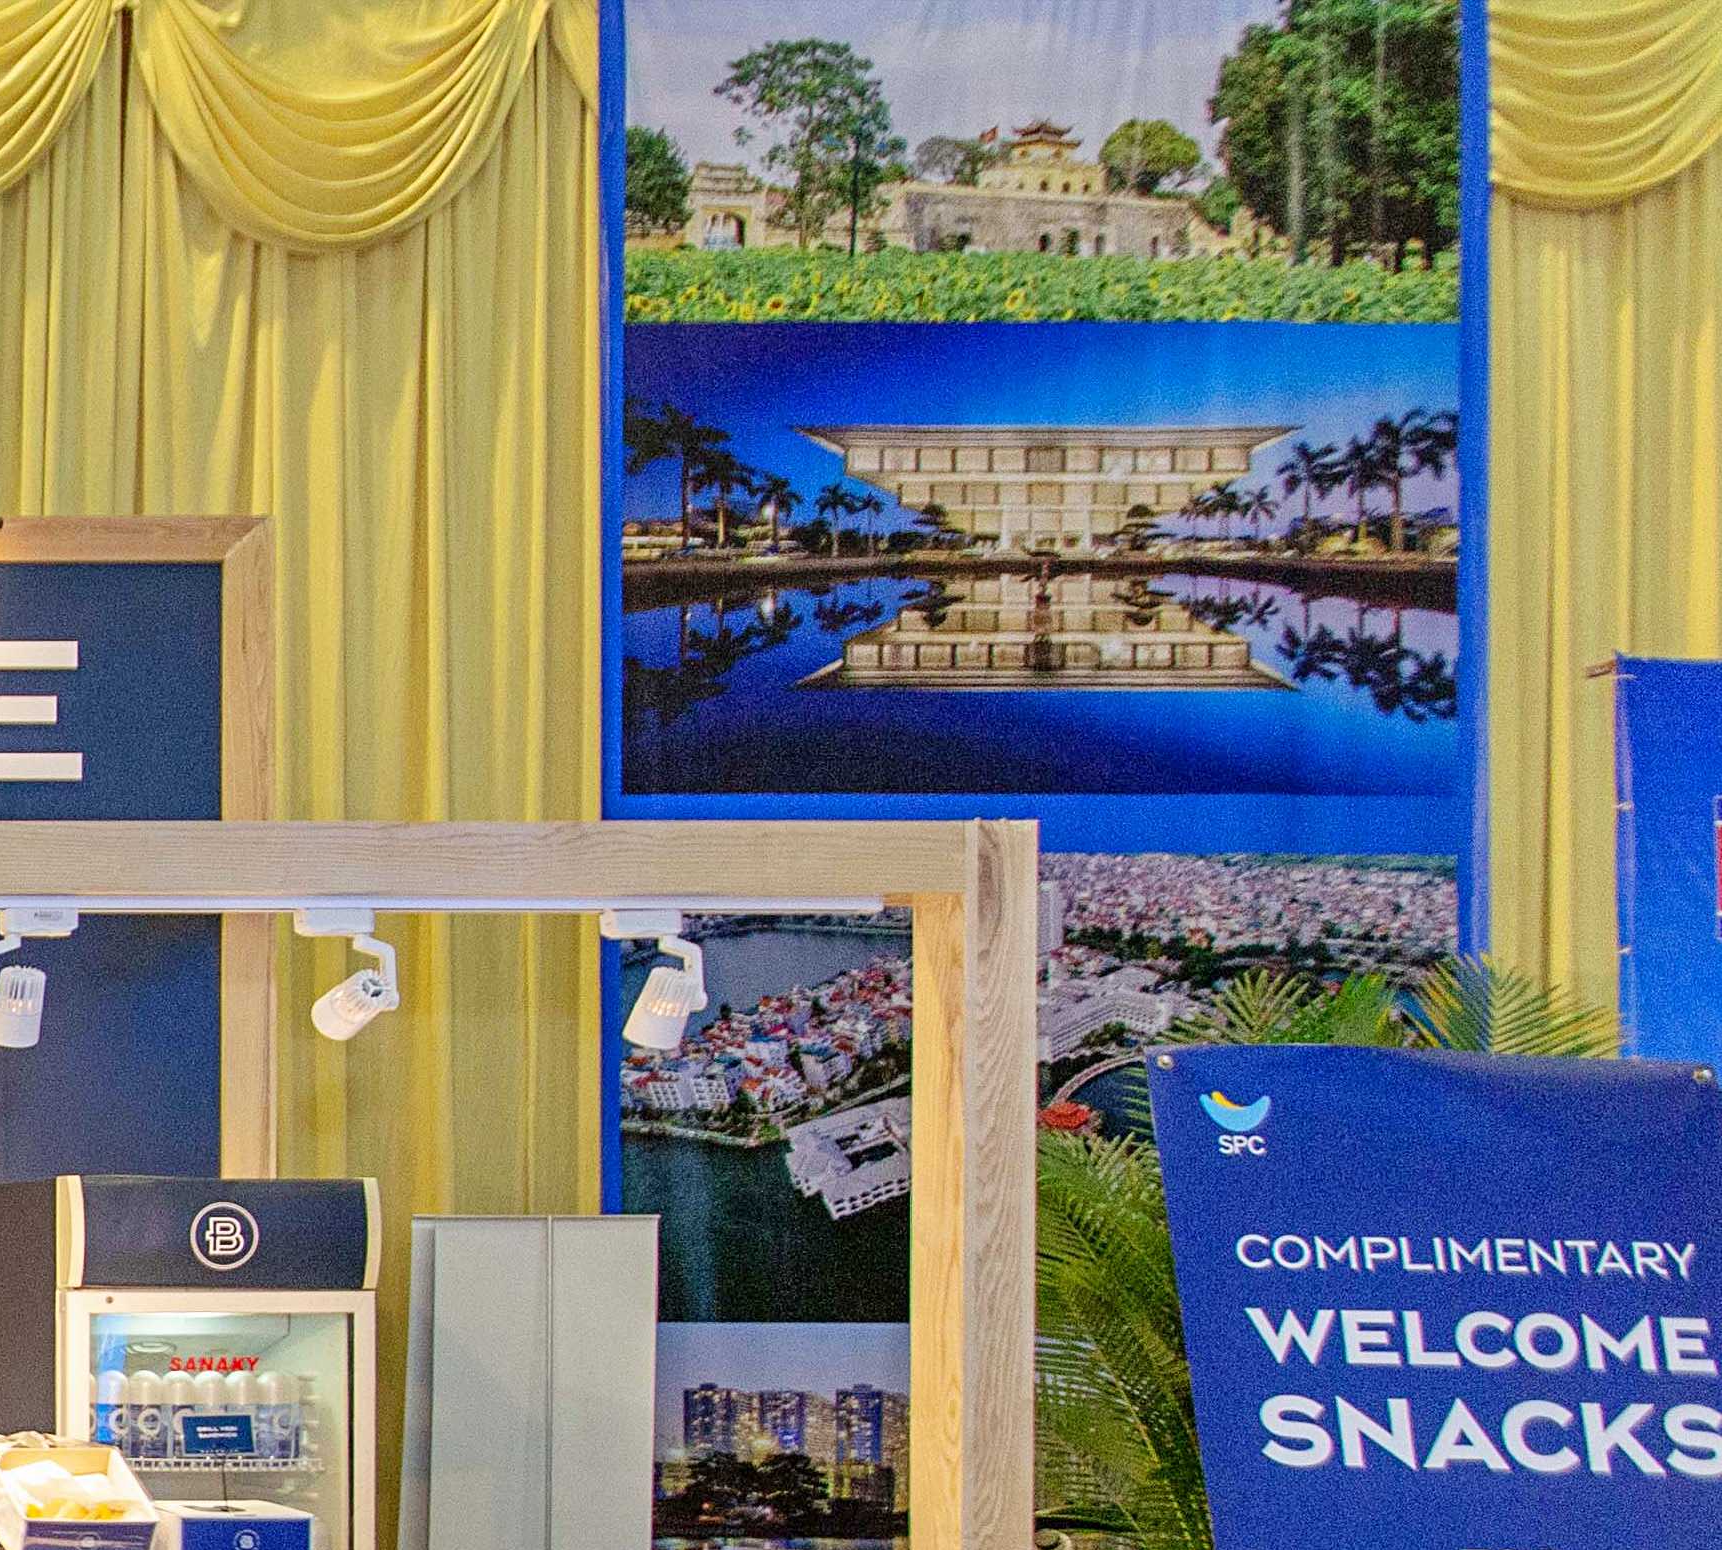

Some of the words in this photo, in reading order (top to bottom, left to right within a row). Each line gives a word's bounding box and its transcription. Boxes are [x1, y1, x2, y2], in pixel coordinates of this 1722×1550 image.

[1218, 1135, 1265, 1155] SPC
[1236, 1234, 1694, 1278] COMPLIMENTARY
[171, 1356, 257, 1372] SANAKY
[1245, 1308, 1717, 1376] WELCOME
[1260, 1395, 1722, 1478] SNACKS
